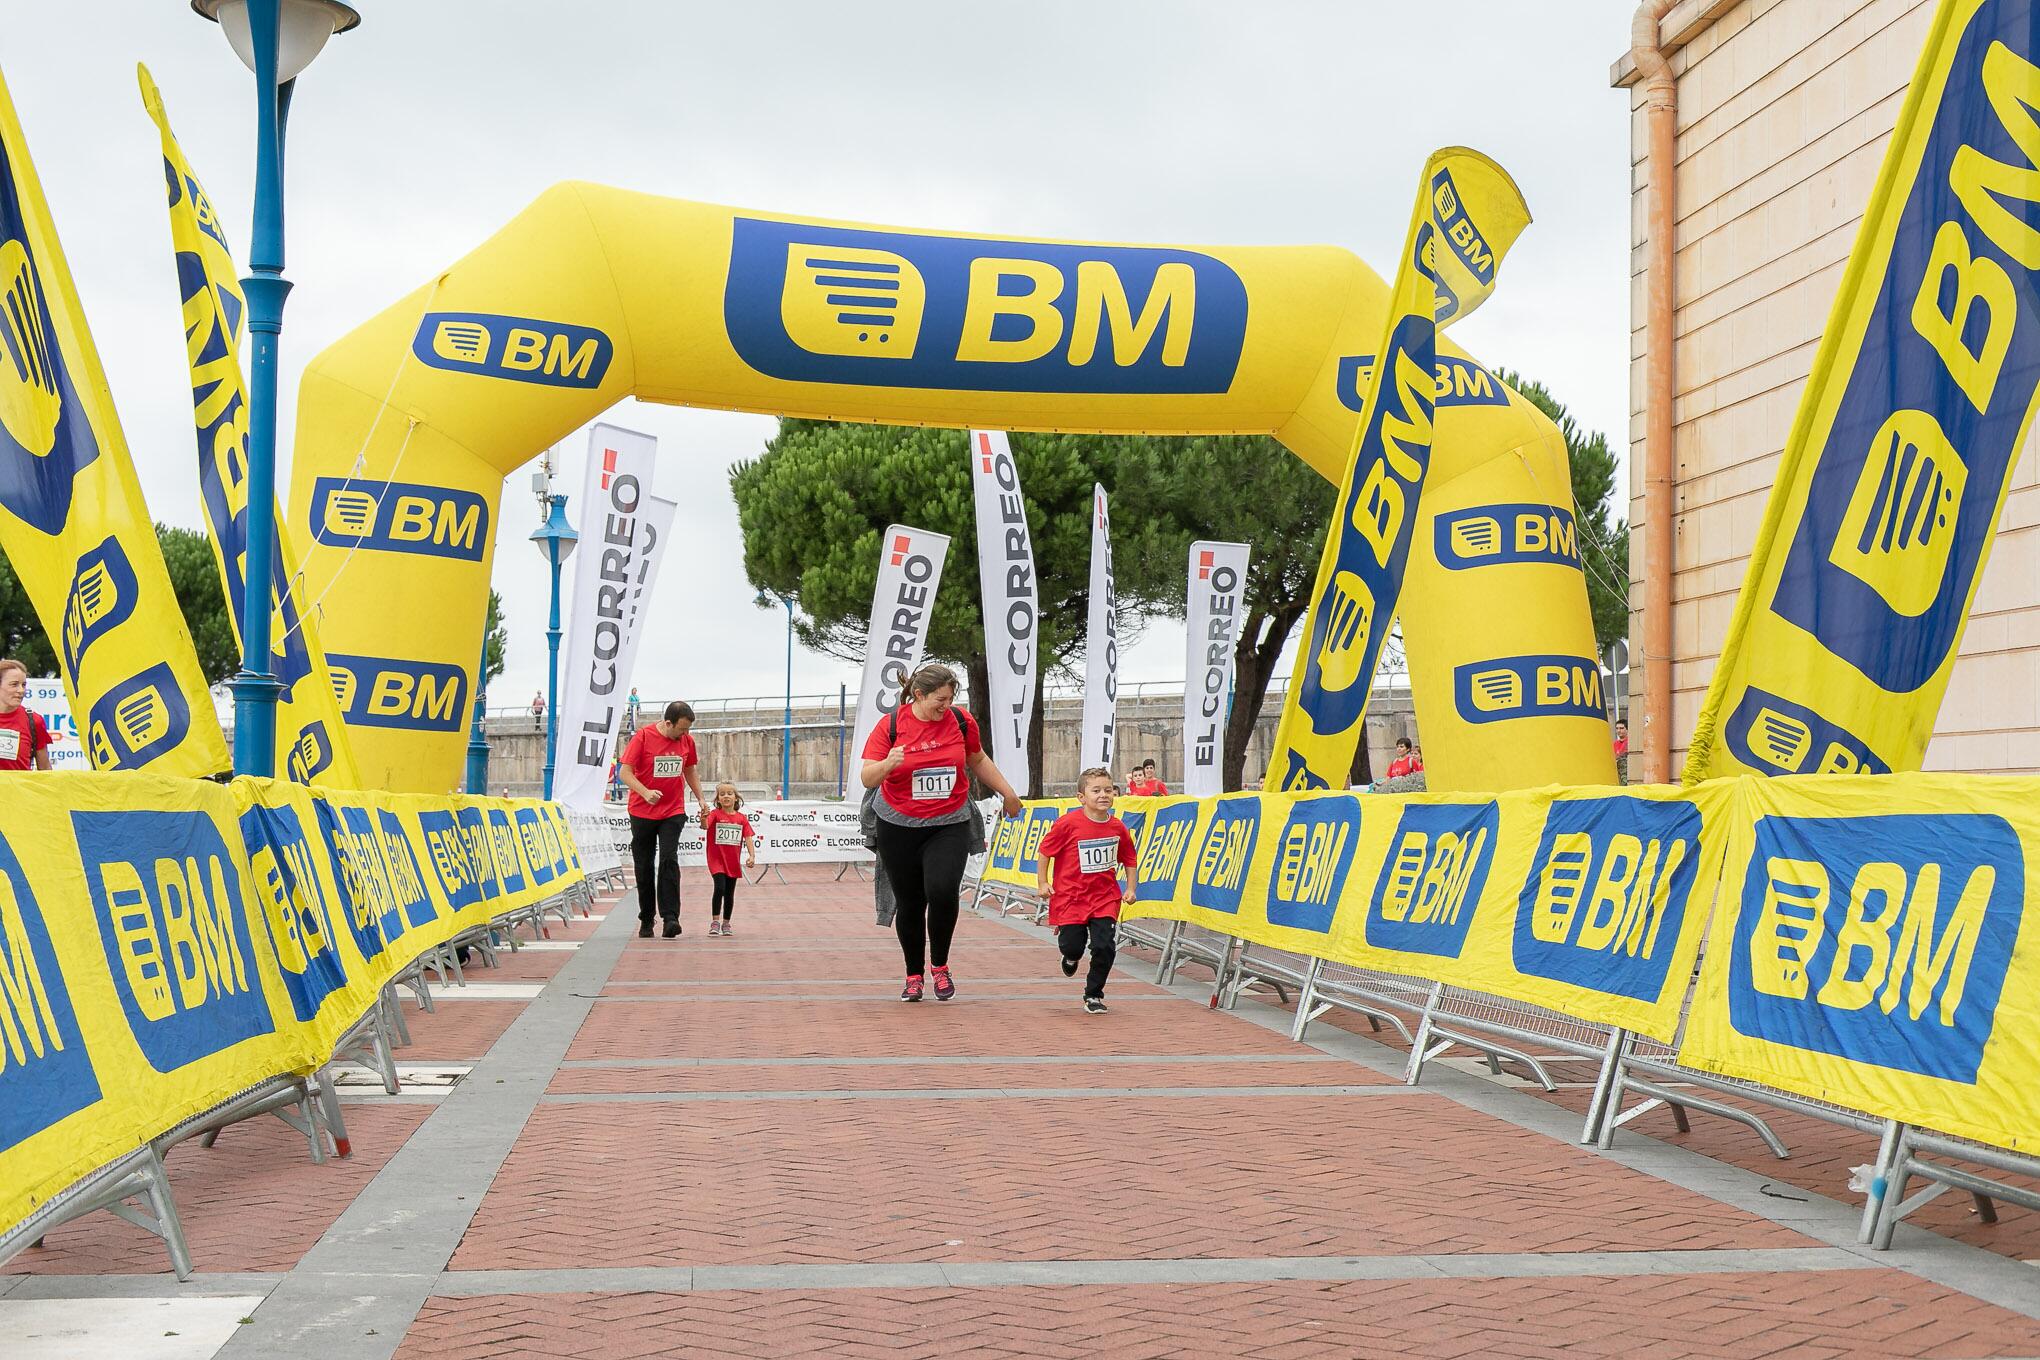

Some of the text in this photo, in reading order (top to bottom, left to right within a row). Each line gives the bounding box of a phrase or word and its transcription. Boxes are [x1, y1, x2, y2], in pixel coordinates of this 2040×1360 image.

[1448, 217, 1494, 274] BM
[955, 257, 1196, 367] BM
[501, 328, 599, 380] BM
[389, 495, 482, 550] BM
[1514, 513, 1578, 560] BM
[588, 474, 641, 696] CORREO
[995, 453, 1034, 676] CORREO
[876, 554, 933, 715] CORREO
[367, 669, 461, 722] BM
[1195, 566, 1238, 766] EL CORREO
[1536, 666, 1602, 710] BM
[577, 705, 614, 768] EL
[657, 762, 680, 773] 2017
[917, 776, 951, 792] 1011
[718, 829, 740, 840] 2017
[770, 840, 780, 848] EL
[782, 839, 818, 848] CORREO
[823, 814, 833, 822] EL
[827, 838, 866, 847] EL CORRE
[1084, 846, 1116, 865] 1011
[1151, 819, 1194, 882] BM
[1211, 818, 1255, 891] BM
[1297, 821, 1350, 907] BM
[1408, 827, 1488, 927] BM
[1576, 832, 1686, 961] BM
[155, 854, 250, 1009] BM
[1817, 862, 1997, 1028] BM
